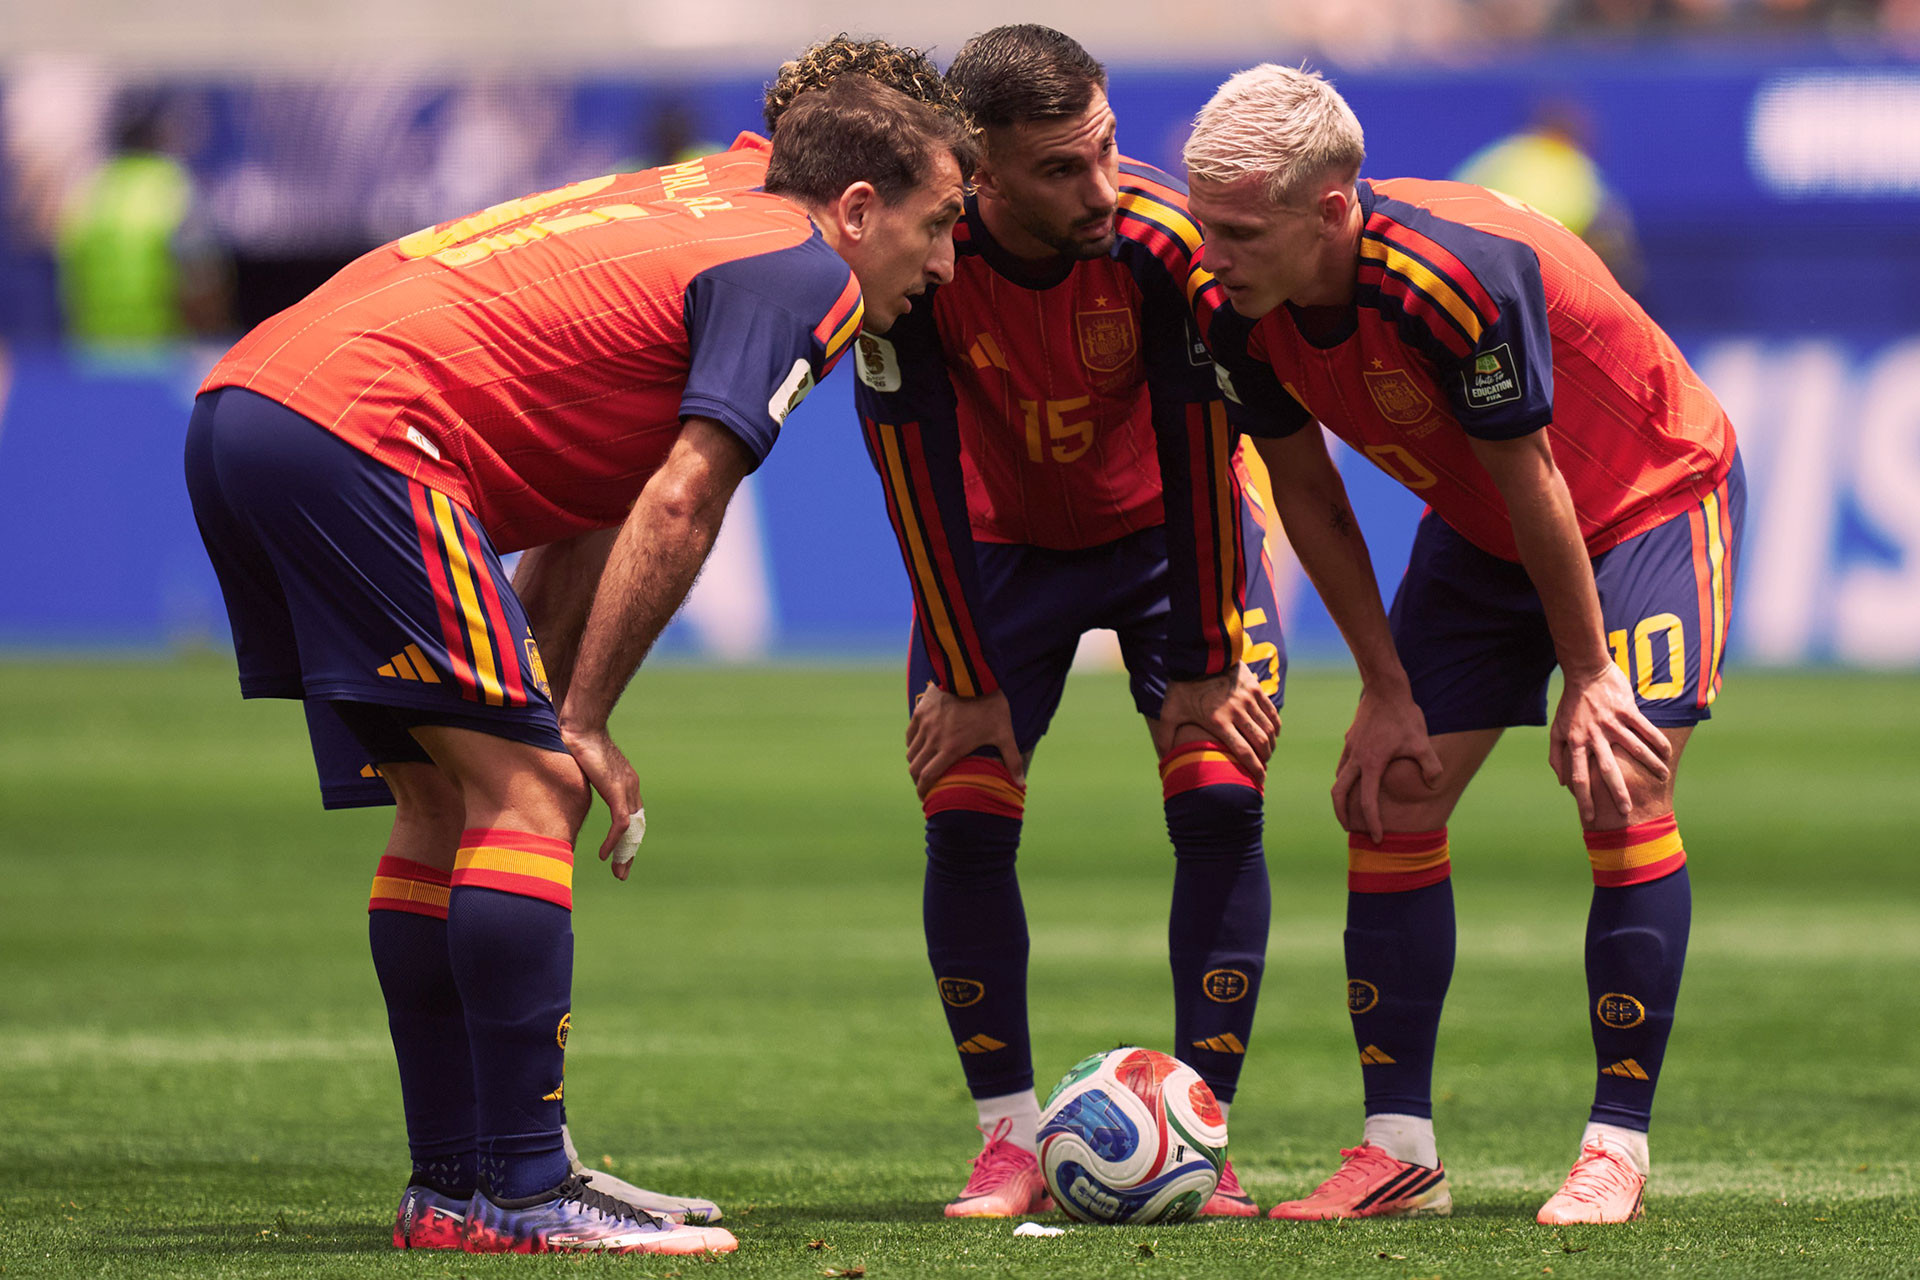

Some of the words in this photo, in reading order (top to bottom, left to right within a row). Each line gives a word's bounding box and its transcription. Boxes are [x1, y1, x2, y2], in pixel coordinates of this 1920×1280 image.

[1472, 379, 1513, 398] EDUCATION
[1486, 393, 1502, 402] FIFA
[1018, 395, 1093, 463] 15
[1352, 443, 1438, 489] 0
[1608, 612, 1686, 701] 10
